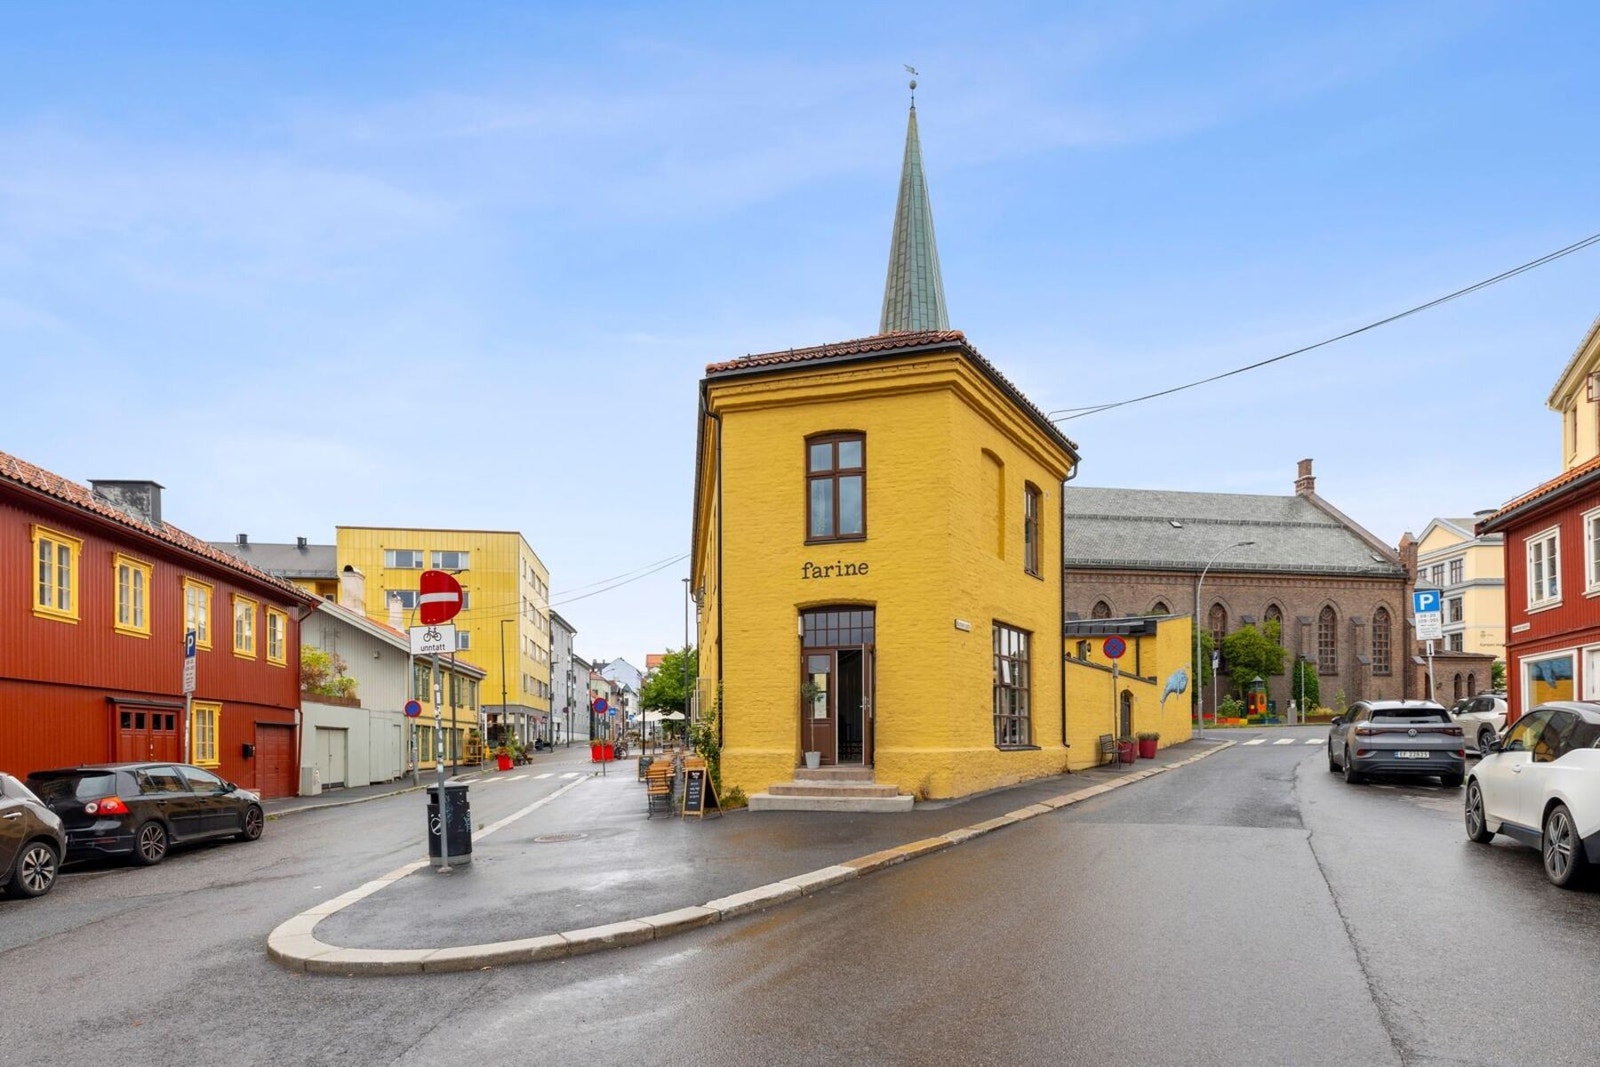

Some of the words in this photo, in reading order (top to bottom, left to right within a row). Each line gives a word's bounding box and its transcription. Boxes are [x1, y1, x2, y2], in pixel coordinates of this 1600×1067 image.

[801, 560, 869, 580] farine
[1419, 593, 1434, 611] P
[187, 635, 194, 656] P
[420, 643, 446, 652] unntatt
